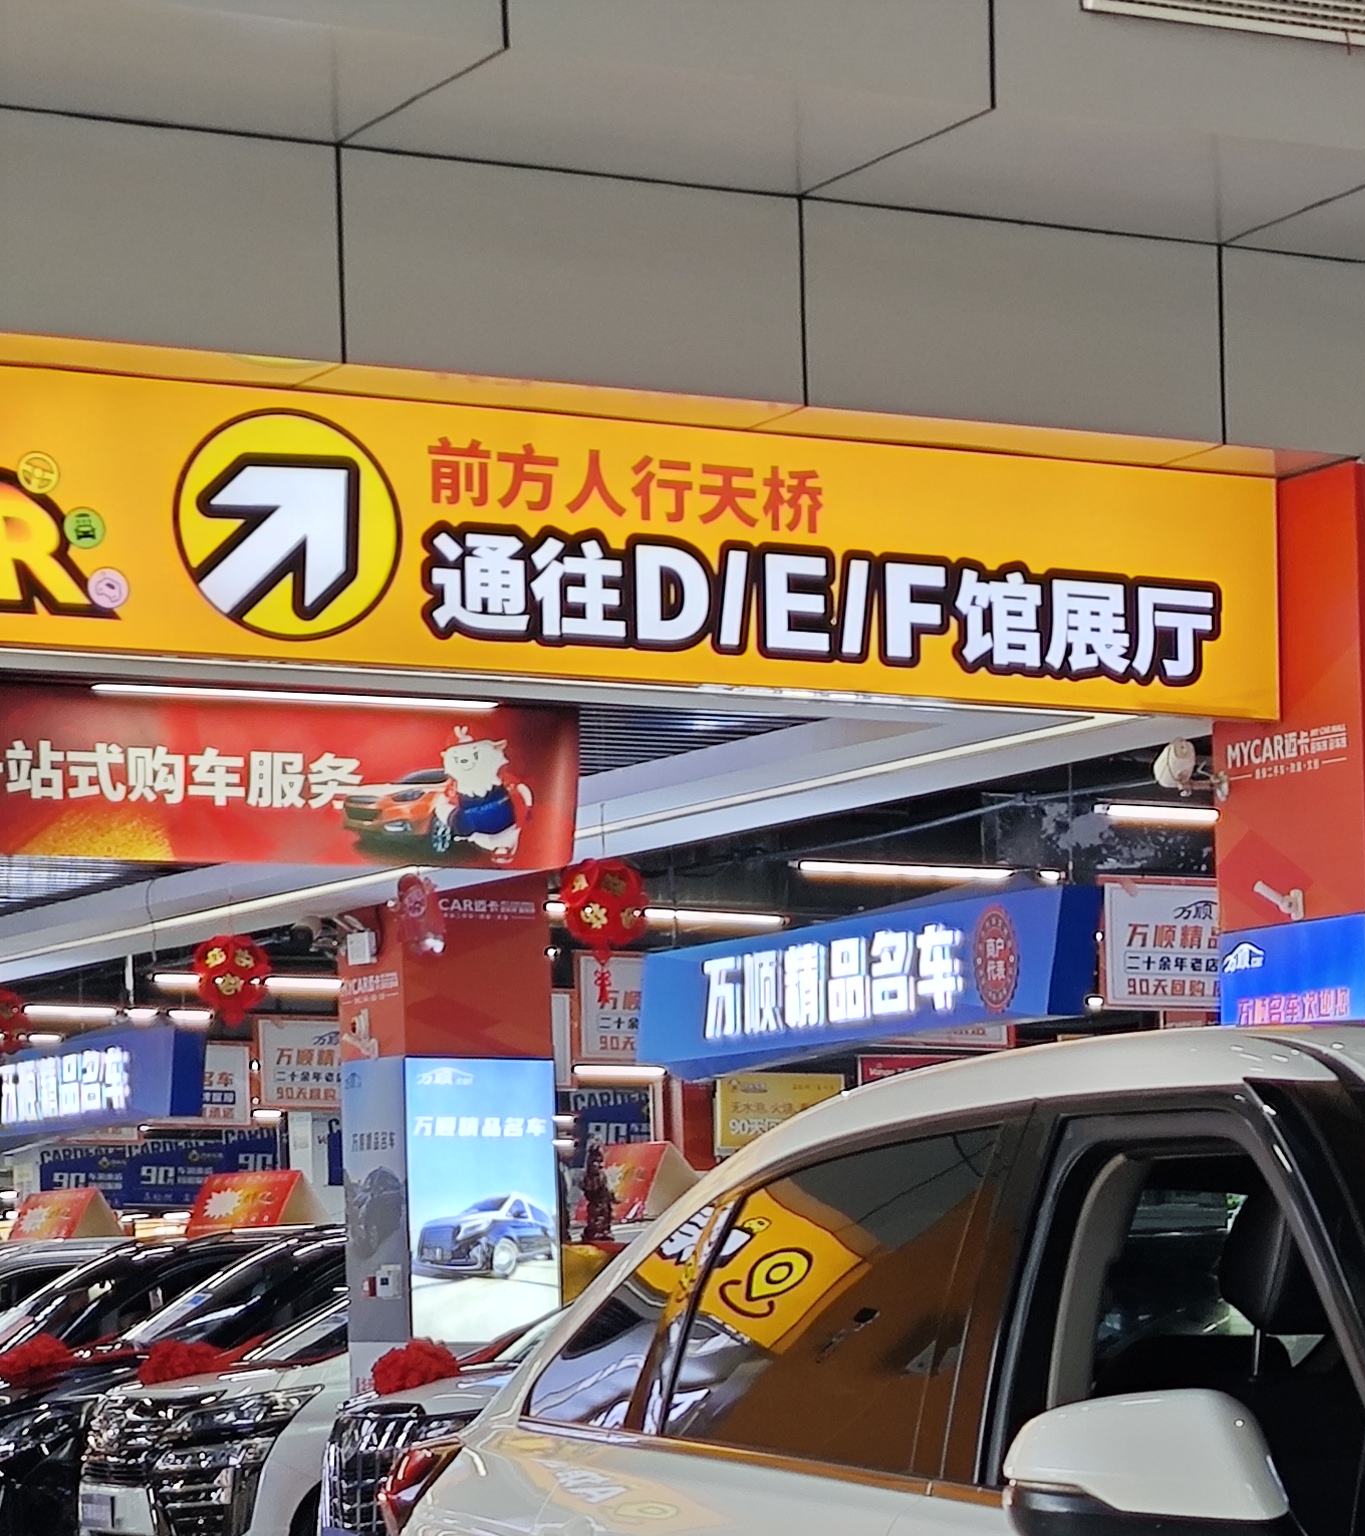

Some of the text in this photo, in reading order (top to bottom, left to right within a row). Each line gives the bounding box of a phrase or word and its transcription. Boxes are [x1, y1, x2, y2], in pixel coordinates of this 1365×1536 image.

[427, 437, 823, 534] 前方人行天桥
[428, 528, 1217, 682] 通往D/E/F馆展厅
[0, 739, 363, 809] 站式购车服务
[702, 922, 964, 1041] 万顺精品名车
[276, 1048, 340, 1066] 万顺精
[414, 1117, 546, 1137] 万顺精品名车
